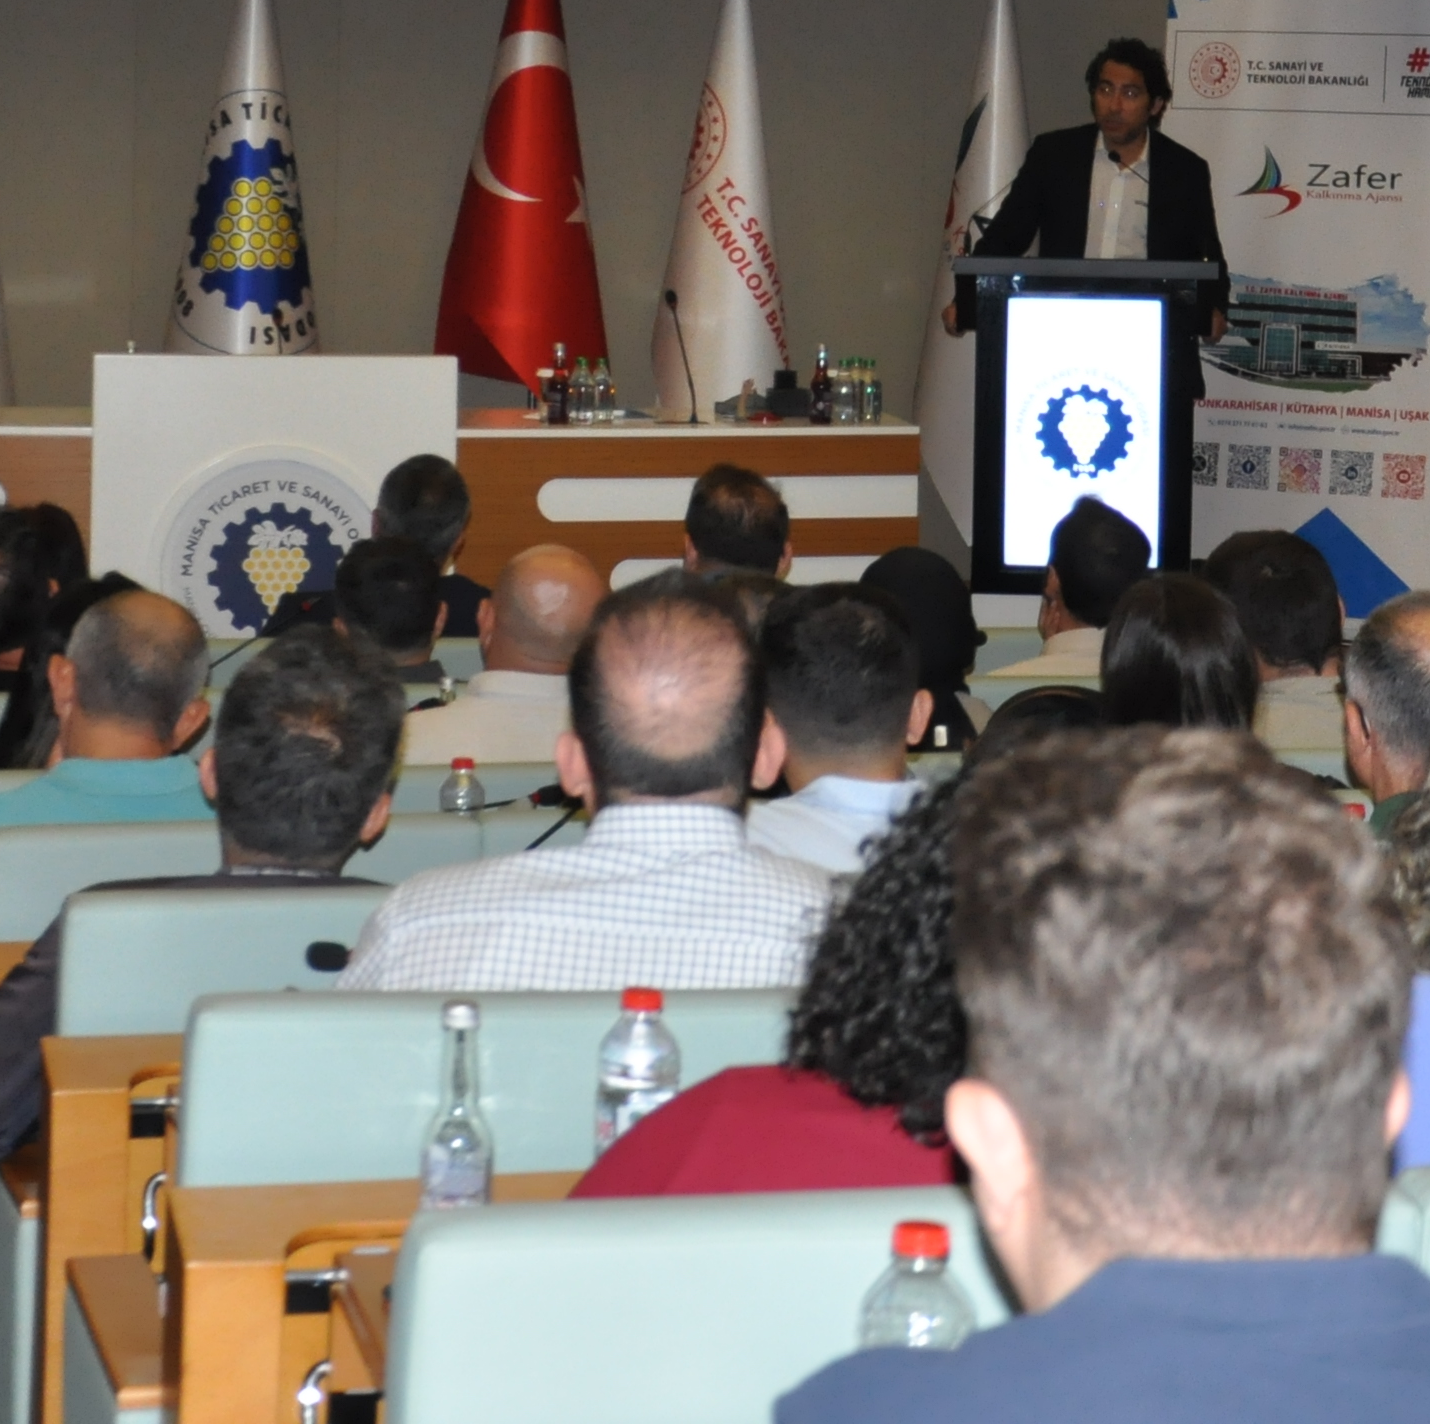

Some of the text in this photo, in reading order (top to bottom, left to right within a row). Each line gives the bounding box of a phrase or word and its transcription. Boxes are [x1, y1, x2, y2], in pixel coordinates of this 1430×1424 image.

[1247, 59, 1324, 71] T.C. SANAYİ VE
[1247, 73, 1369, 87] TEKNOLOJİ BAKANLIĞI
[1307, 163, 1403, 189] Zafer
[716, 177, 746, 218] T.C.
[697, 194, 773, 309] TEKNOLOJİ
[1286, 400, 1337, 417] KÜTAHYA
[1346, 404, 1391, 420] MANİSA
[1400, 408, 1430, 423] UŞAK
[208, 480, 272, 515] TİCARET
[277, 480, 298, 494] VE
[301, 485, 353, 527] SANAYİ
